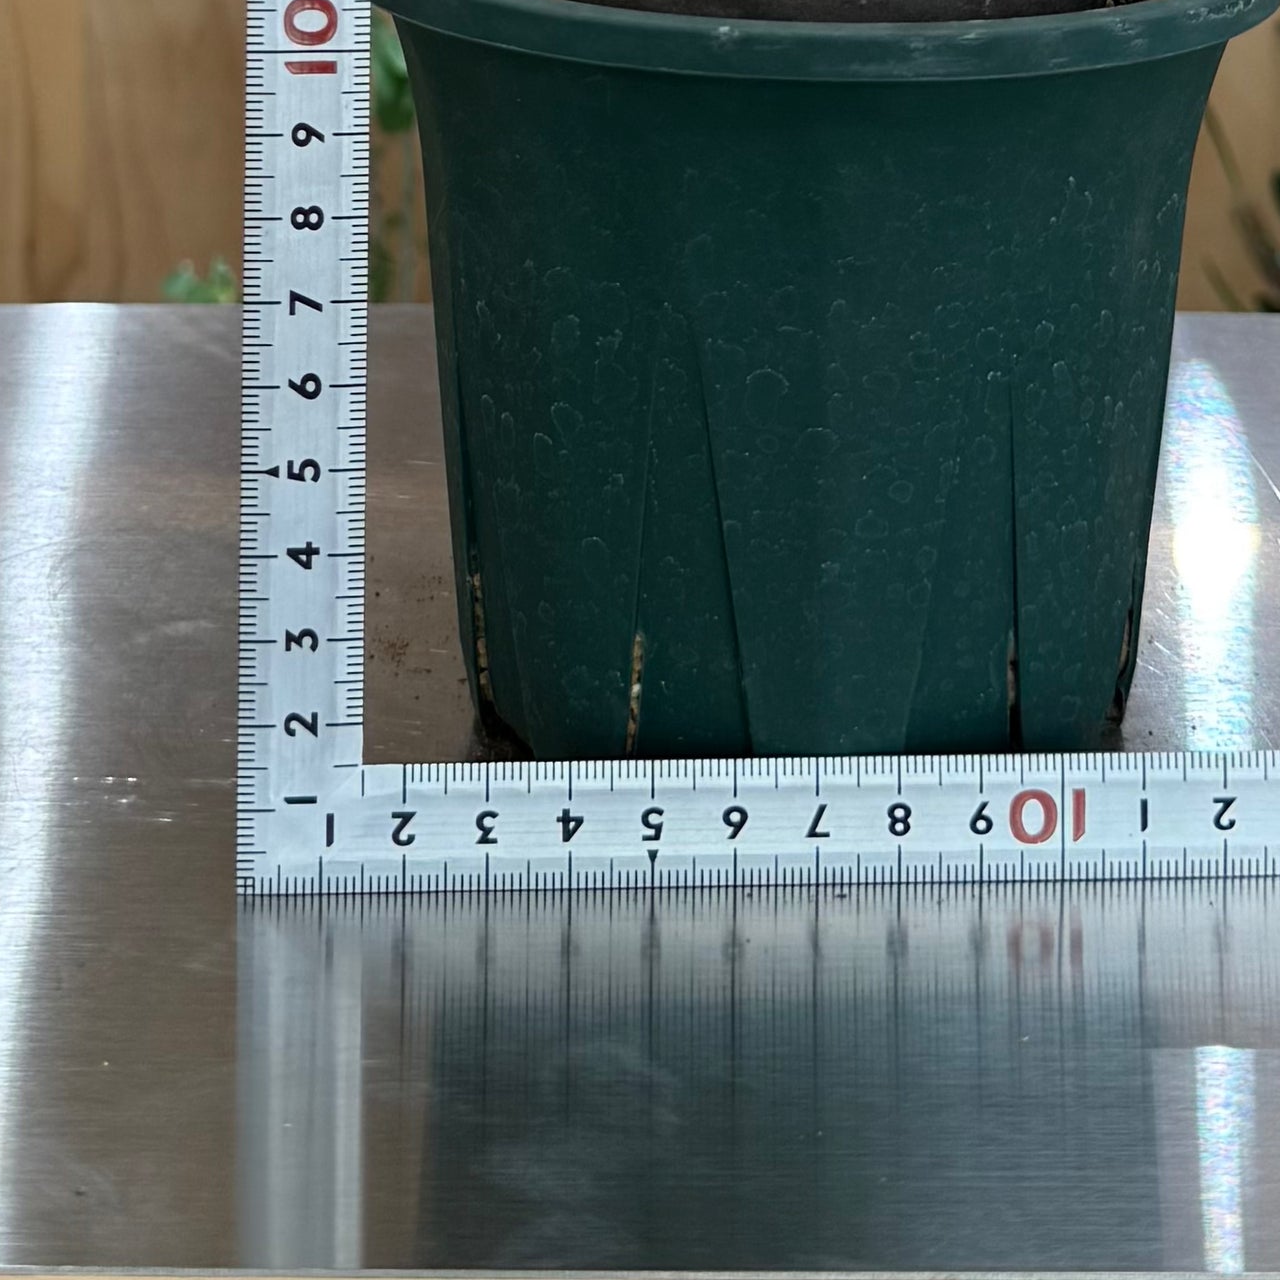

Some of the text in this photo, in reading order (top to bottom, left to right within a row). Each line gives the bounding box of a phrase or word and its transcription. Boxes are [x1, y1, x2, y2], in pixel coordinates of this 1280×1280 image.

[292, 123, 325, 147] 9
[291, 206, 324, 230] 8
[289, 290, 323, 316] 7
[288, 373, 322, 400] 6
[287, 459, 321, 483] 5
[286, 541, 320, 570] 4
[285, 628, 319, 653] 3
[284, 712, 318, 738] 2
[284, 795, 317, 805] 1
[325, 813, 335, 847] 1
[391, 812, 416, 846] 2
[476, 811, 499, 844] 3
[556, 808, 584, 842] 4
[641, 807, 664, 841] 5
[722, 806, 748, 839] 6
[806, 804, 830, 838] 7
[887, 803, 911, 836] 8
[970, 801, 993, 835] 9
[1009, 789, 1086, 844] 10
[1140, 799, 1149, 832] 1
[1213, 797, 1236, 830] 2
